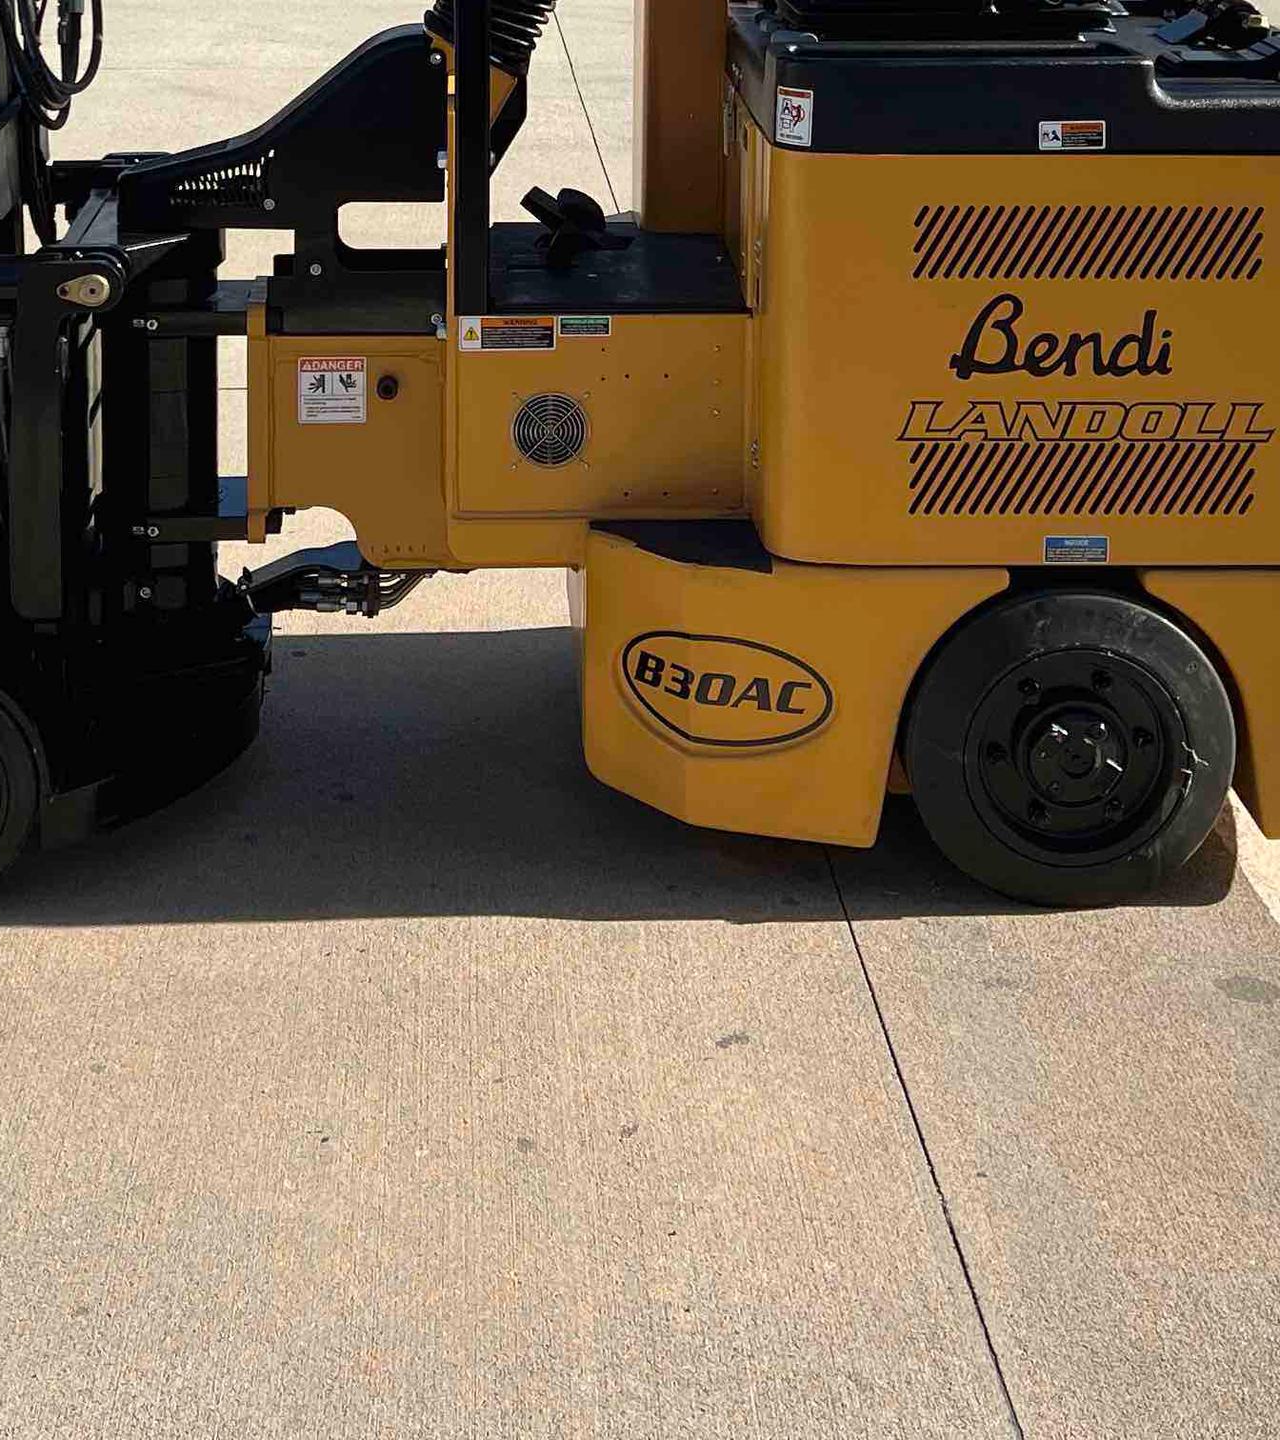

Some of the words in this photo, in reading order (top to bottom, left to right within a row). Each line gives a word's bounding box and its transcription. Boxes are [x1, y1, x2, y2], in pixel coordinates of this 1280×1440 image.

[950, 293, 1173, 380] Bendi
[311, 360, 363, 371] DANGER
[896, 400, 1276, 442] LANDOLL
[634, 650, 812, 714] B30AC
